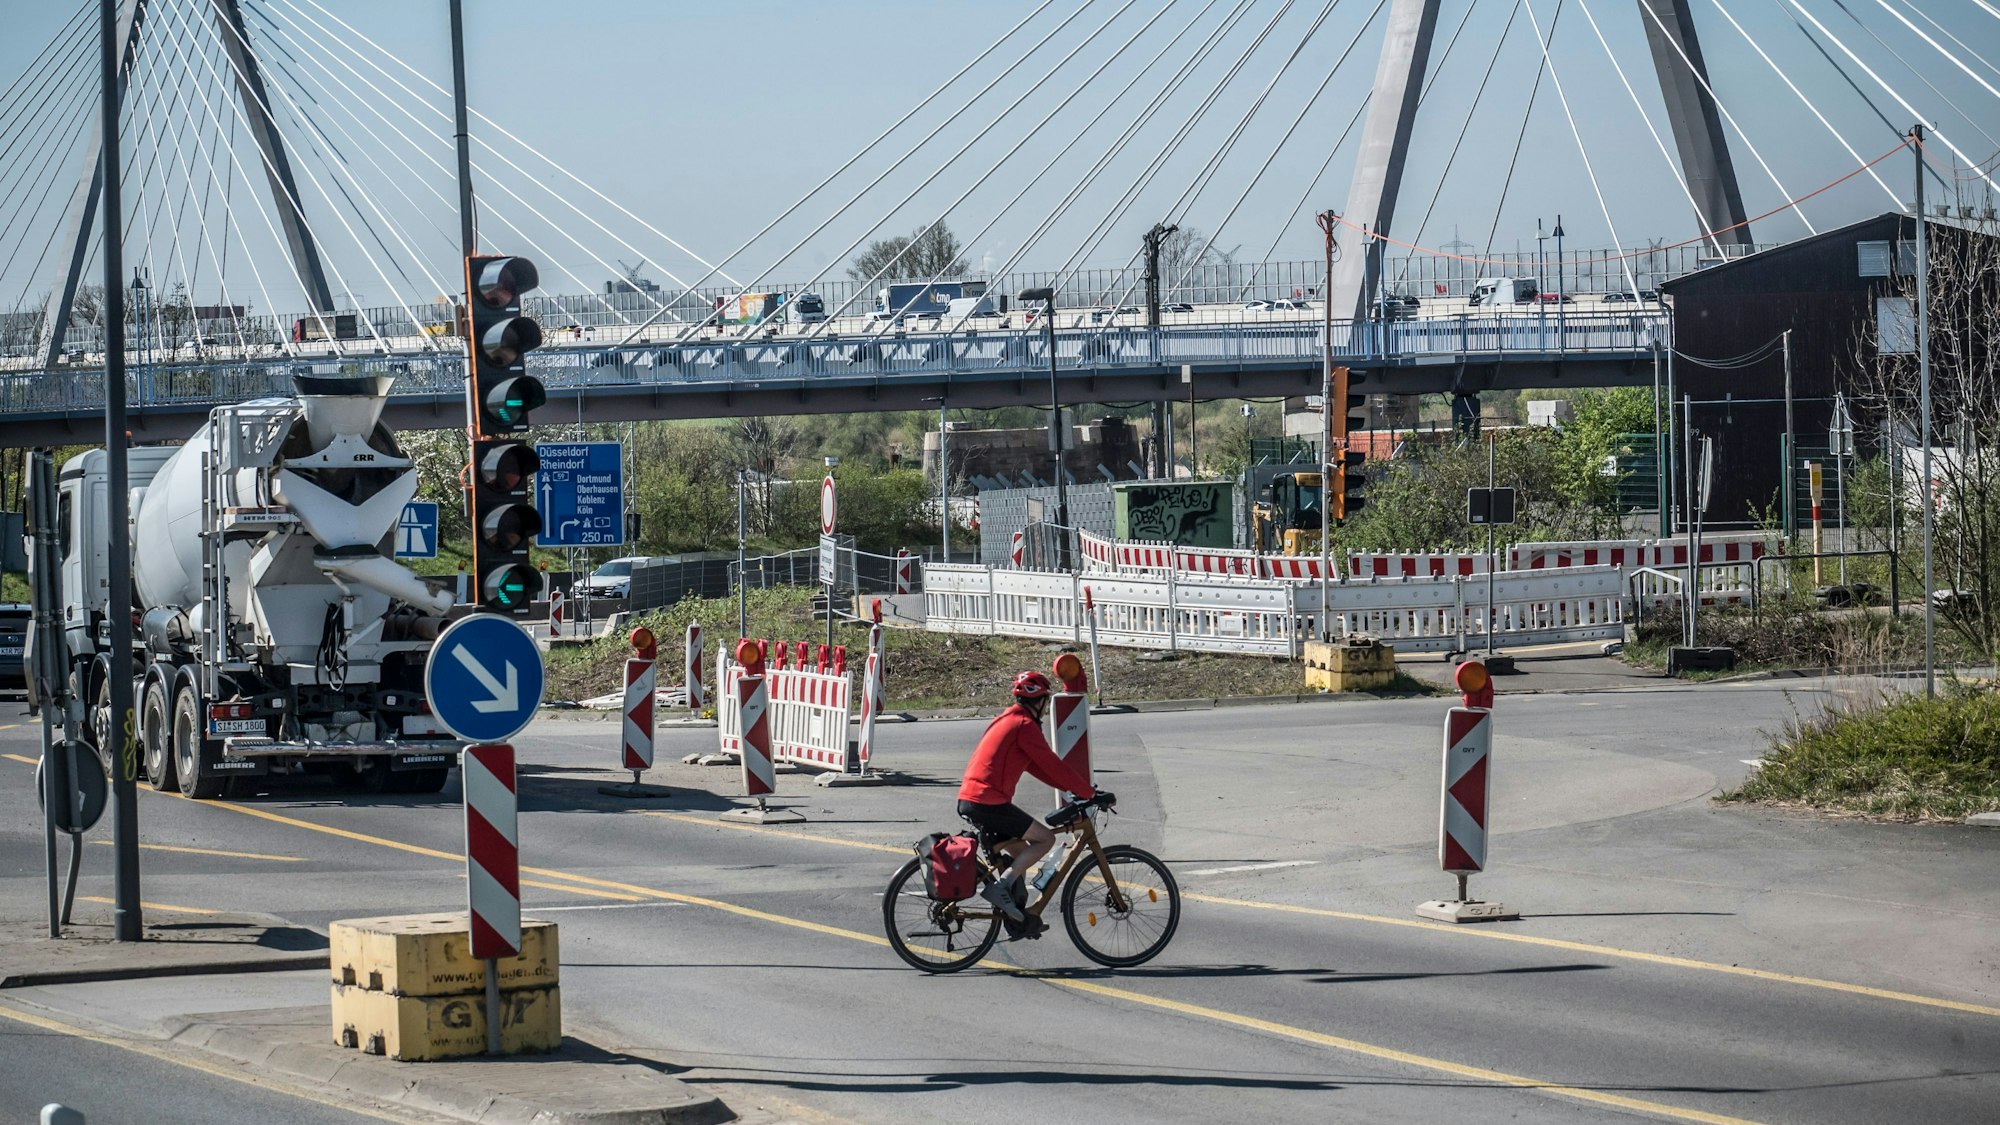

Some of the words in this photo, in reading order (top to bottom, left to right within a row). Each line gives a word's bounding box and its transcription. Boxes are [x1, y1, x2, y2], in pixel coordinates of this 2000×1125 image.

[540, 446, 589, 457] Düsseldorf
[540, 459, 584, 469] Rheindorf
[577, 474, 612, 483] Dortmund
[577, 485, 618, 494] Oberhausen
[577, 495, 605, 504] Koblenz
[577, 505, 593, 514] Köln
[582, 532, 600, 542] 250
[604, 534, 614, 542] m
[218, 722, 226, 732] SI
[232, 722, 243, 730] SH
[244, 720, 264, 730] 1800
[402, 756, 445, 764] LIEBHERR
